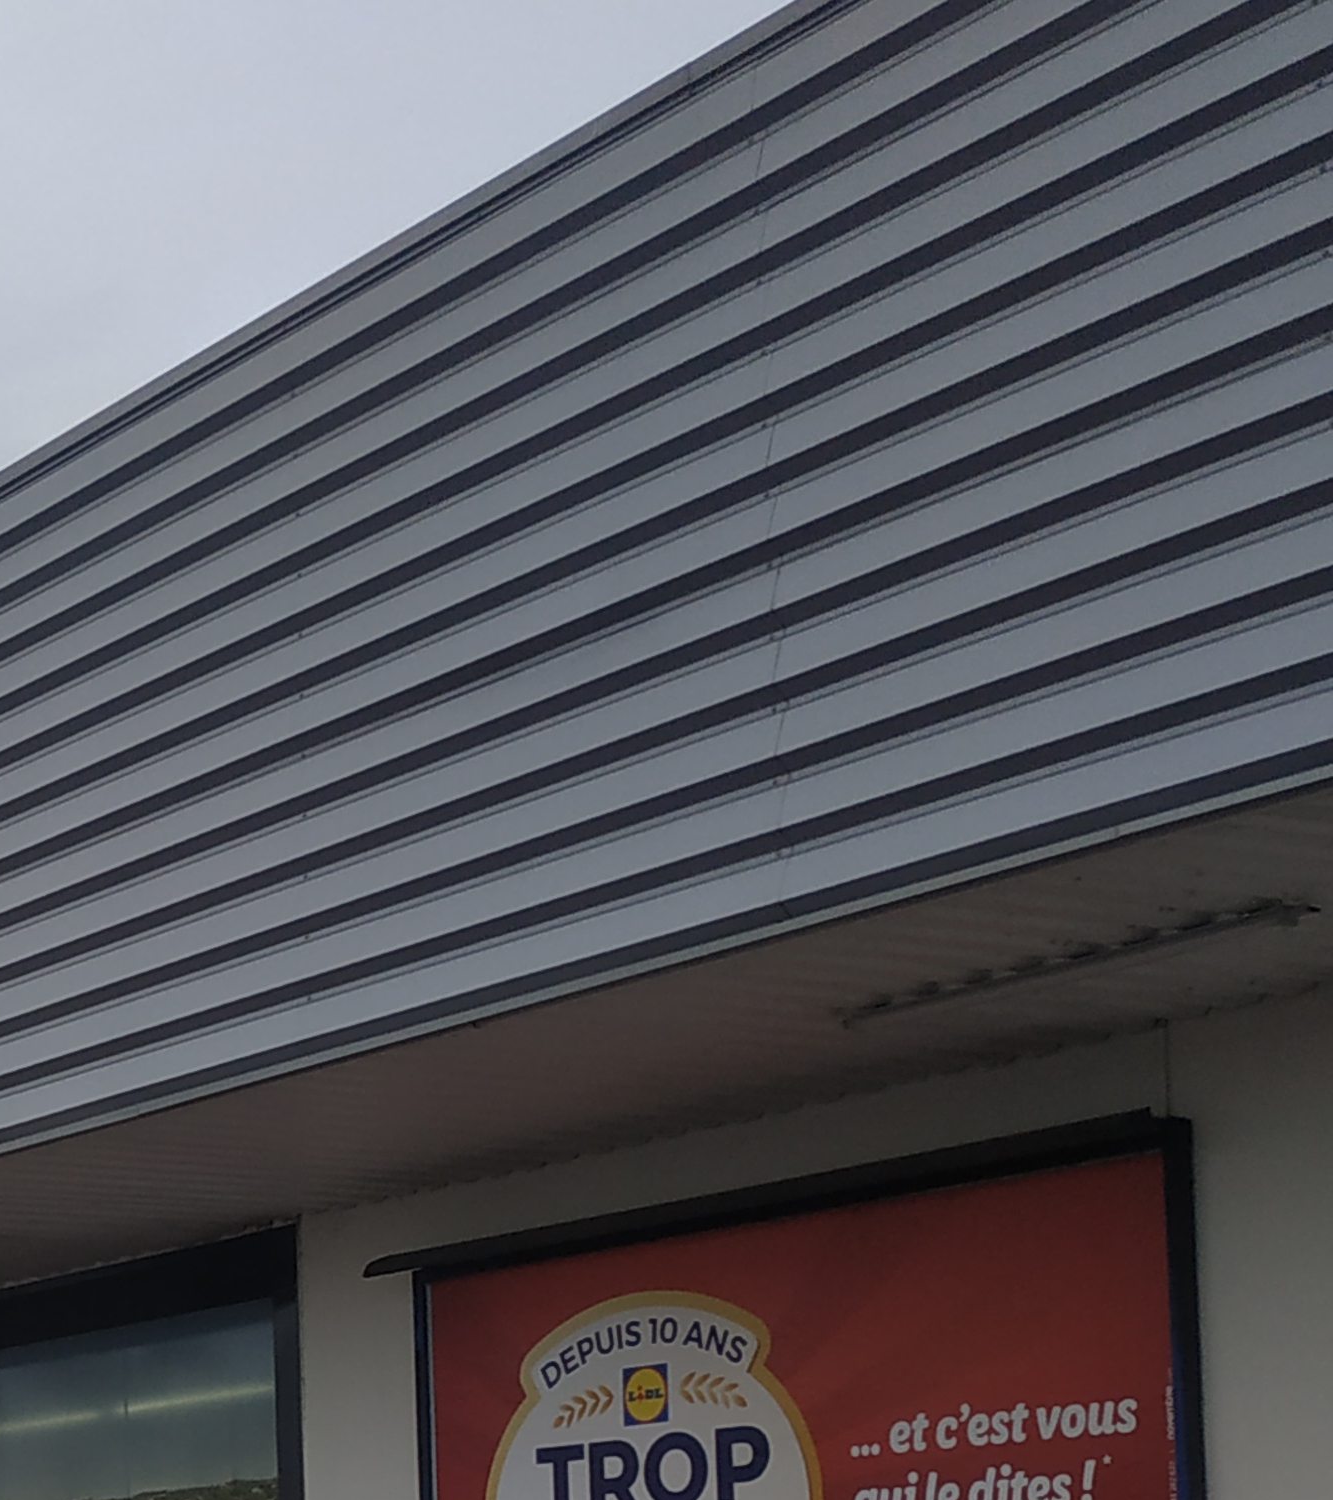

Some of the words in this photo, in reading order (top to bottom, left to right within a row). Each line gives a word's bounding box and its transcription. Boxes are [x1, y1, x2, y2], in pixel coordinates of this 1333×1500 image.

[540, 1320, 642, 1389] DEPUIS
[648, 1317, 678, 1344] 10
[682, 1321, 748, 1363] ANS
[889, 1412, 929, 1453] et
[1036, 1398, 1138, 1440] vous
